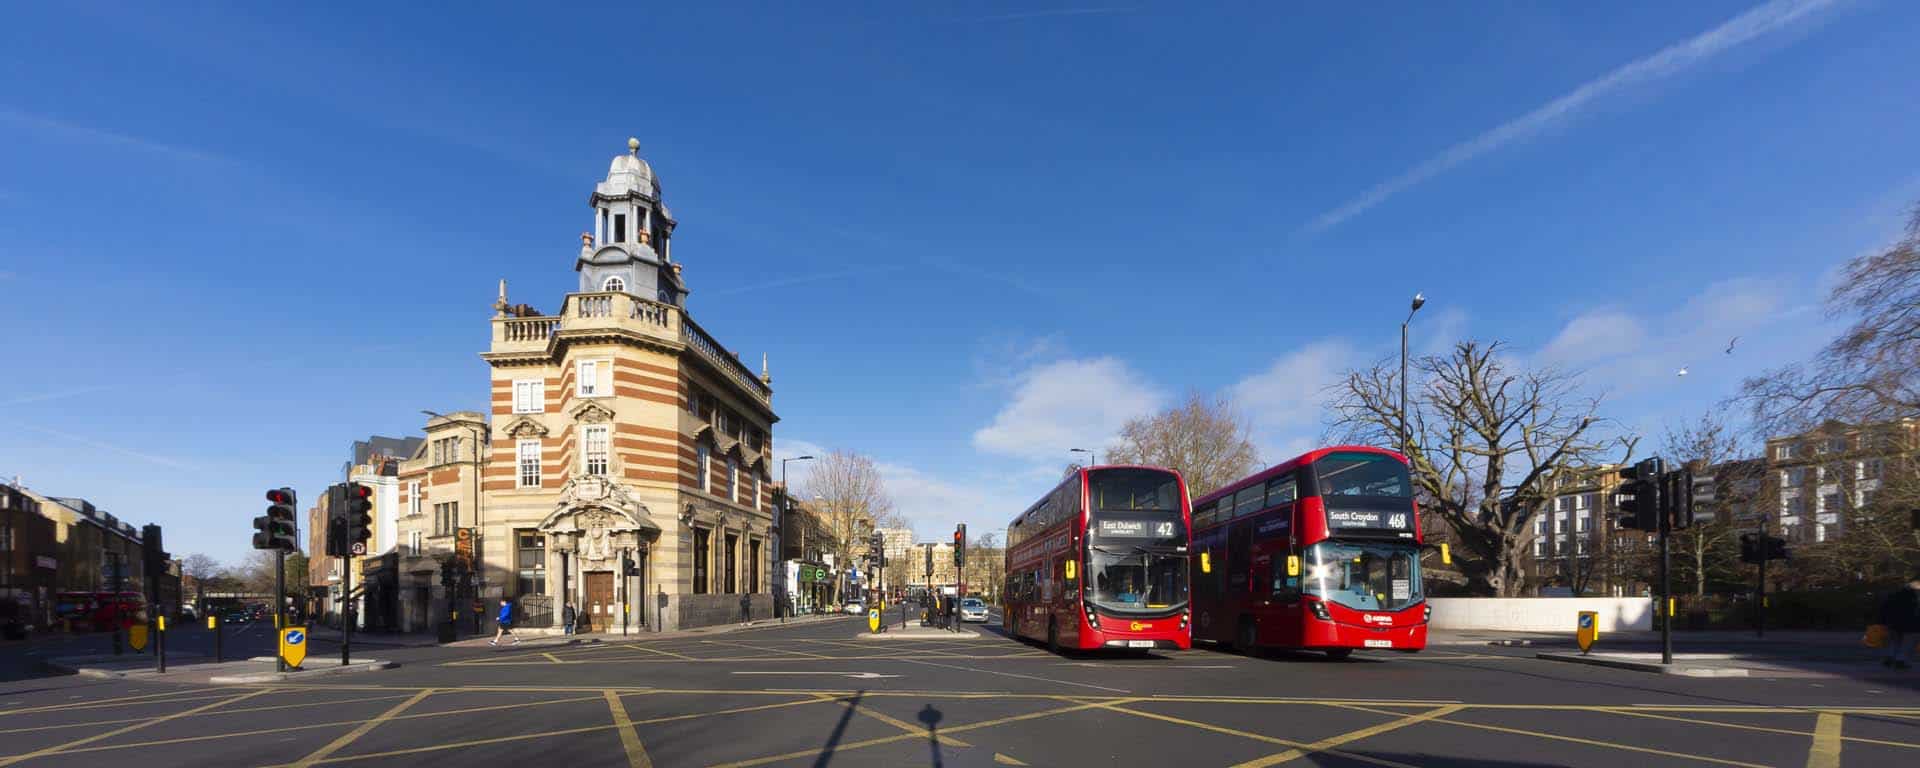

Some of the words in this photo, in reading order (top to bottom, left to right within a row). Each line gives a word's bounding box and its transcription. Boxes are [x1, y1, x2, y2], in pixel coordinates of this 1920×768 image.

[1330, 511, 1350, 520] South
[1351, 511, 1378, 522] Croydon
[1388, 513, 1406, 528] 468
[1103, 520, 1116, 529] East
[1158, 522, 1173, 536] 42
